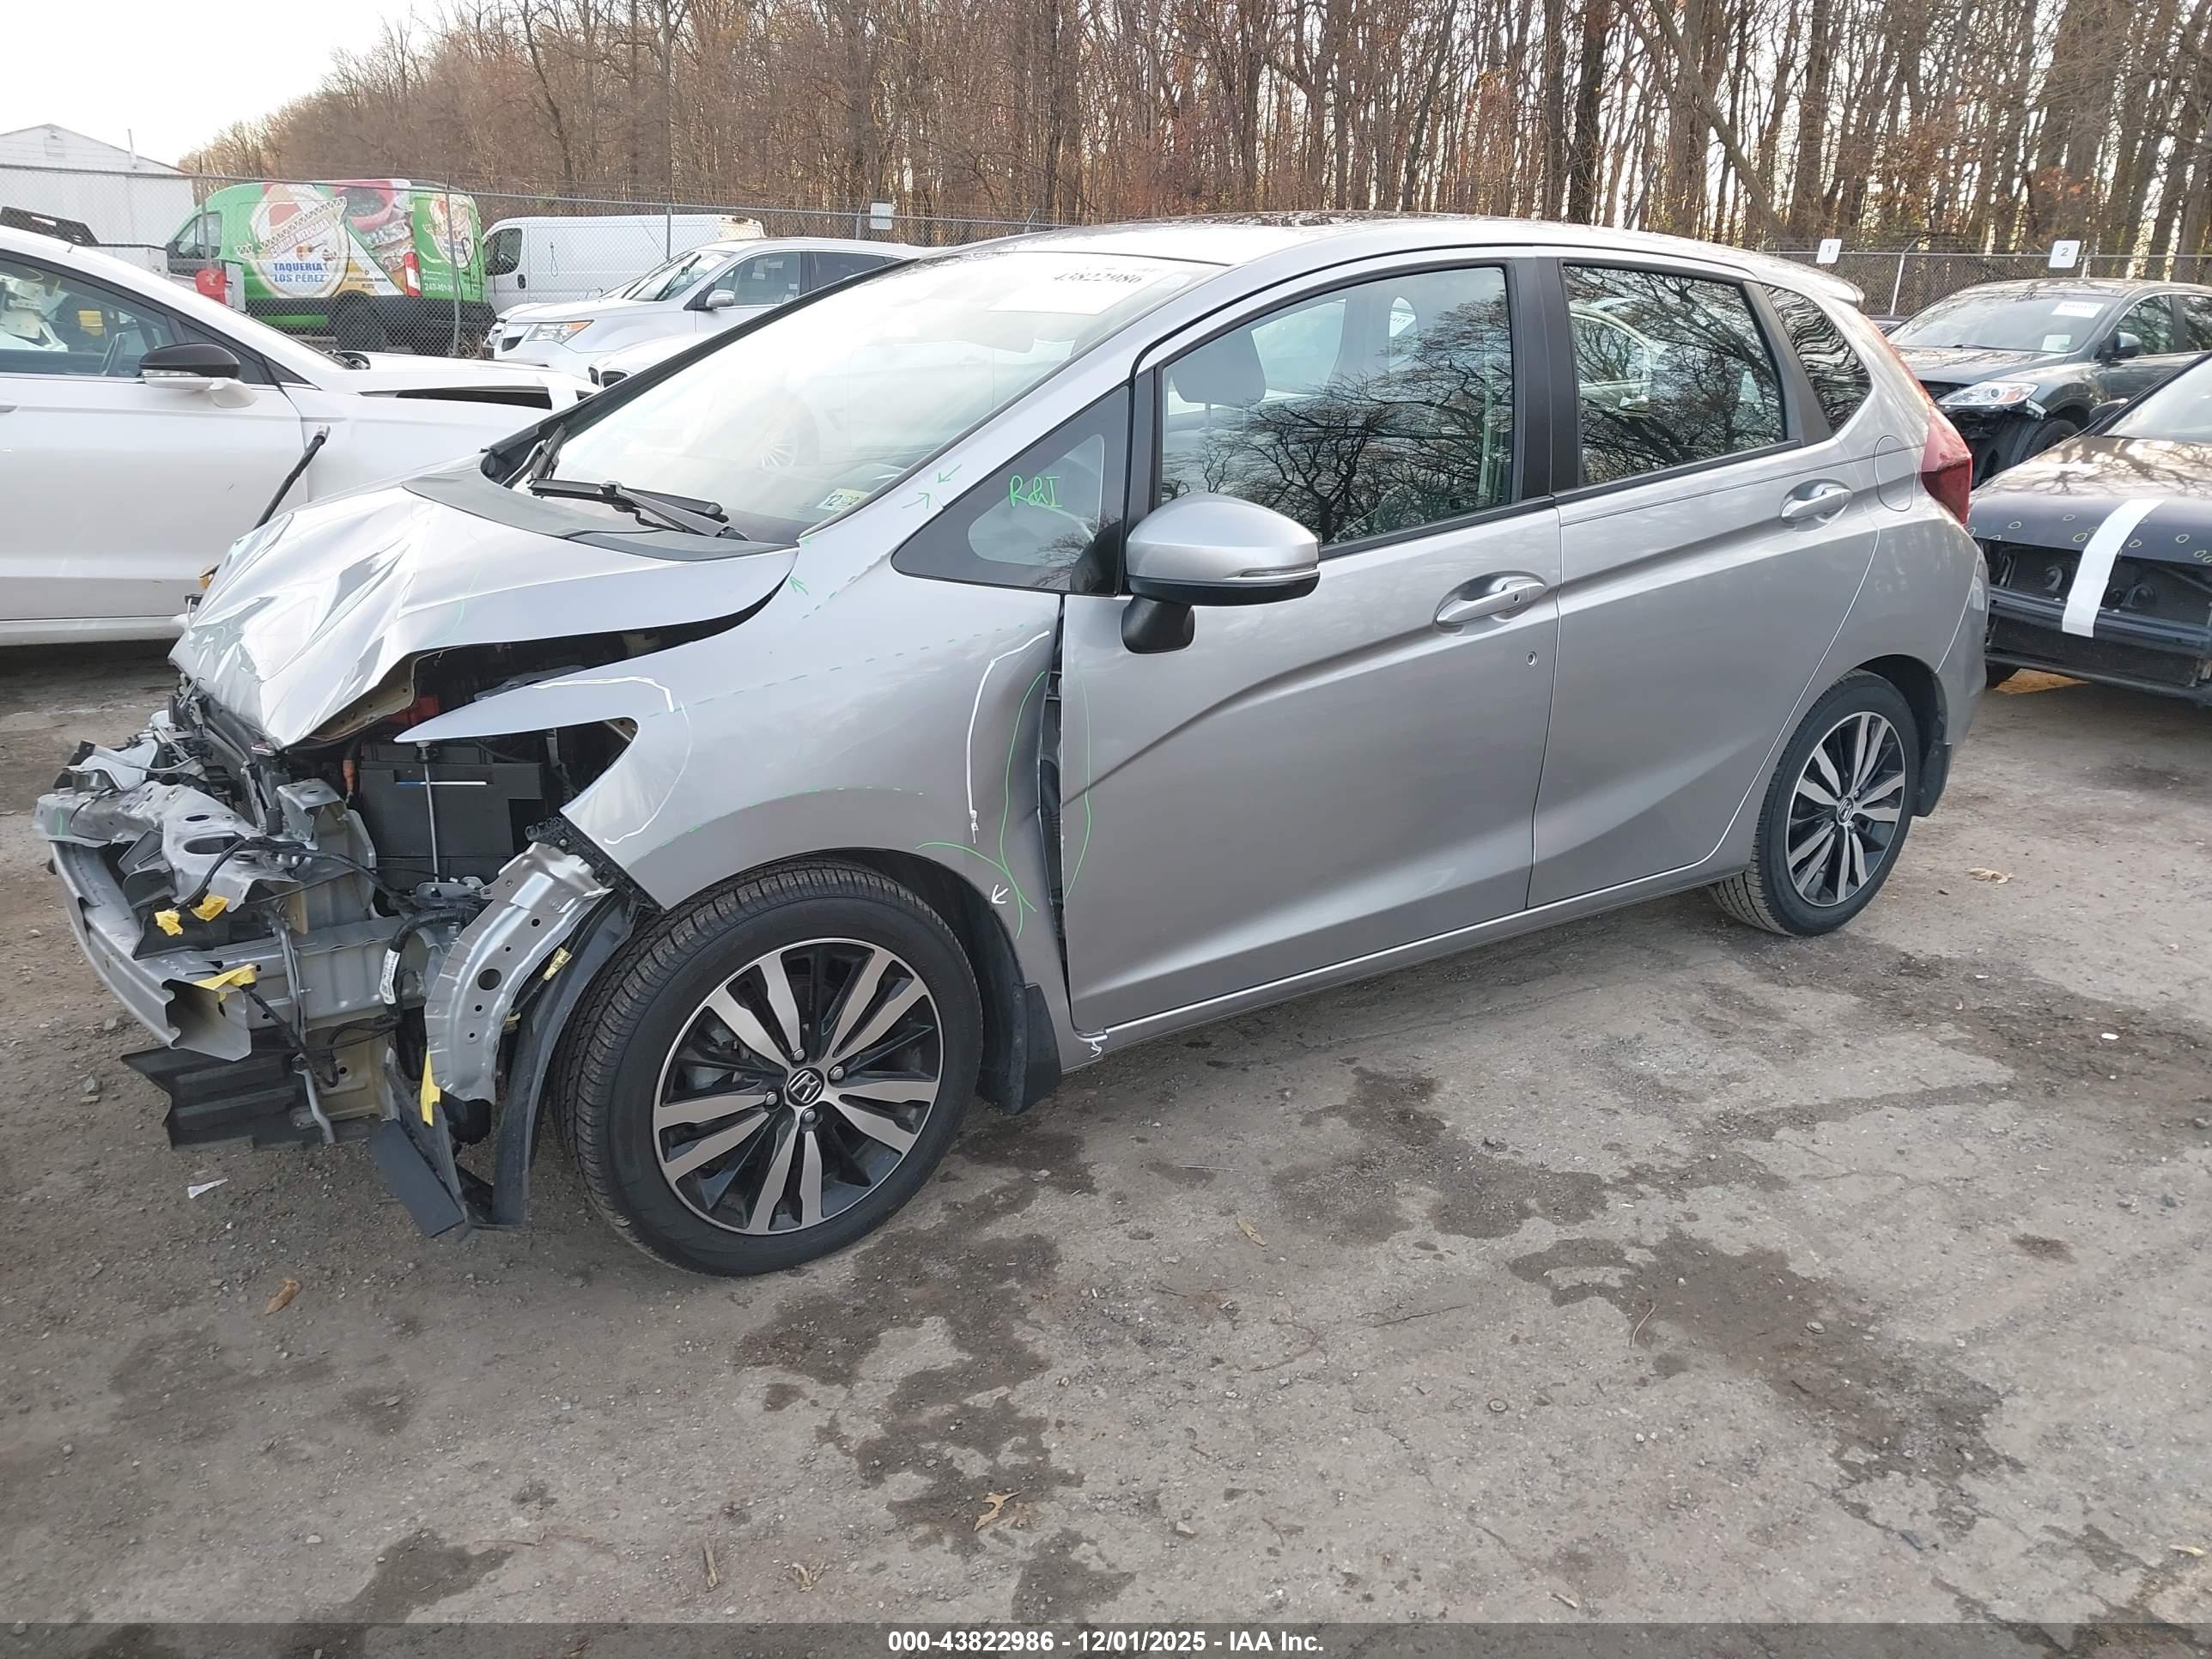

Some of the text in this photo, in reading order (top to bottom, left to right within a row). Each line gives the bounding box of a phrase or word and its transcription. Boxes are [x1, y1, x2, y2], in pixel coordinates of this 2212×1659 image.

[1826, 245, 1832, 253] 1
[2060, 246, 2069, 257] 2
[1009, 474, 1064, 508] R&I
